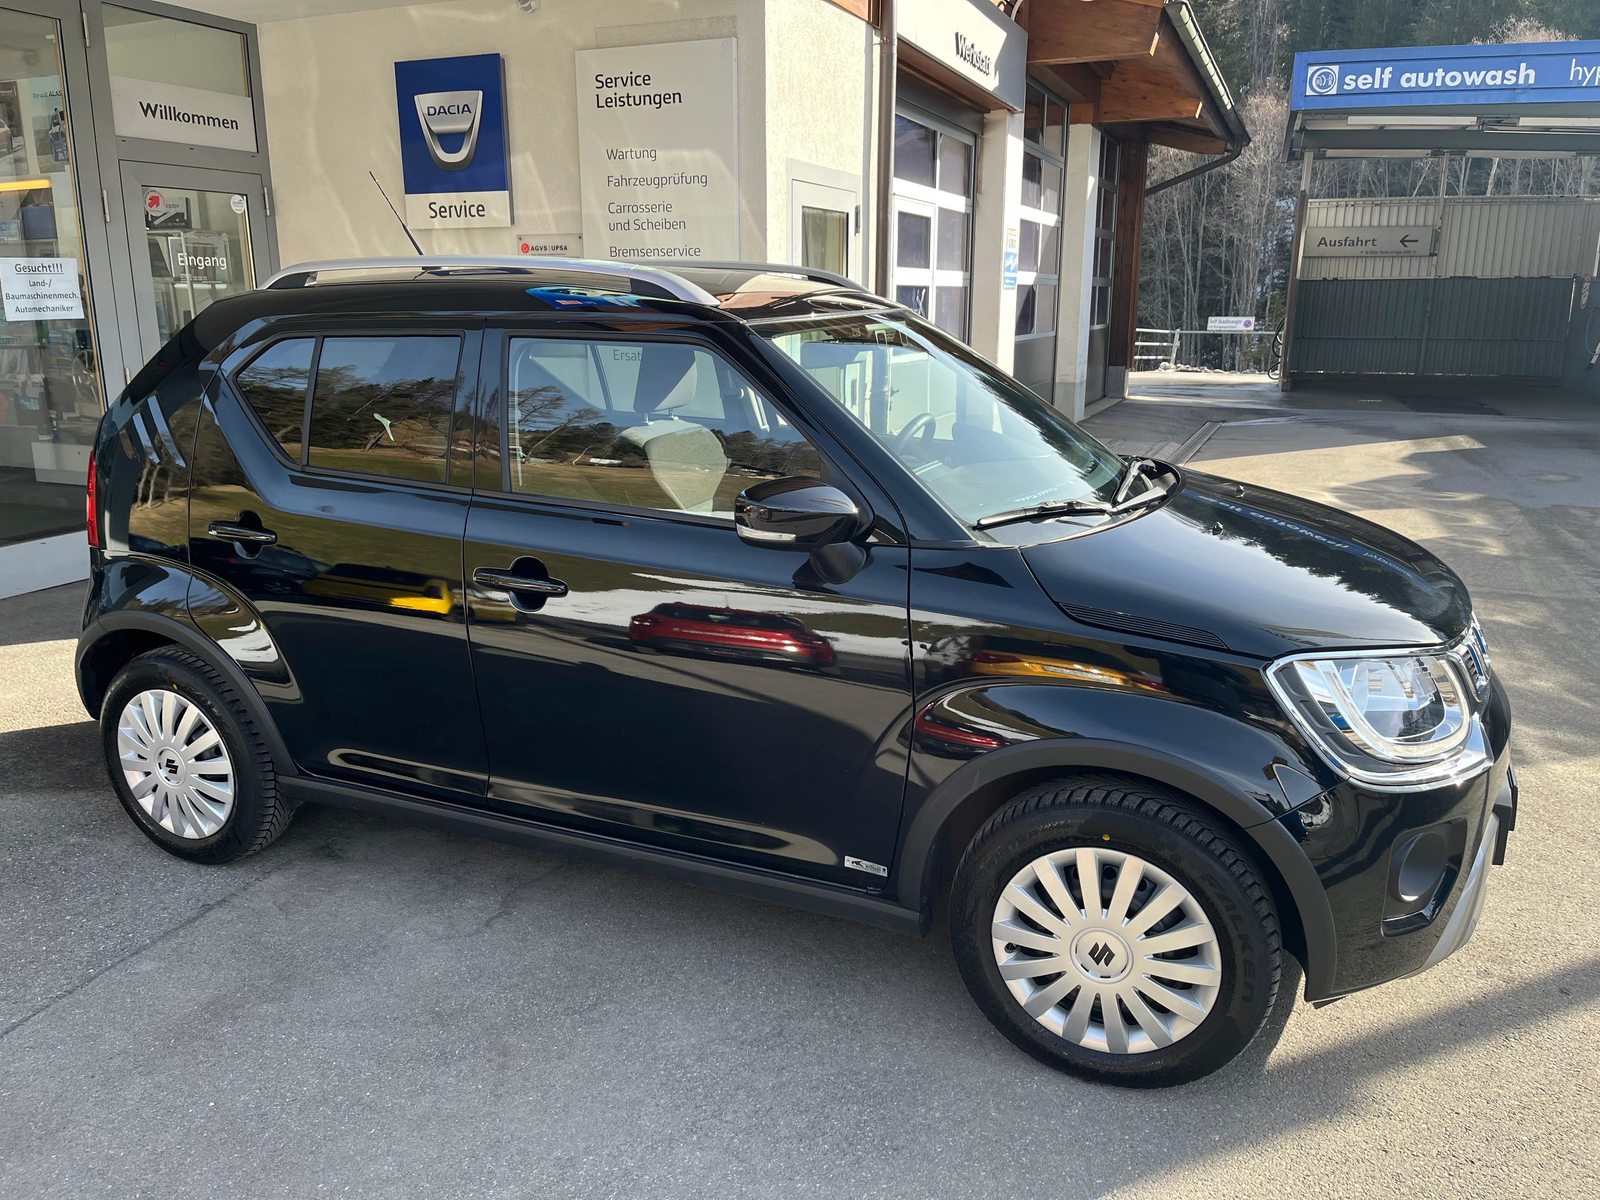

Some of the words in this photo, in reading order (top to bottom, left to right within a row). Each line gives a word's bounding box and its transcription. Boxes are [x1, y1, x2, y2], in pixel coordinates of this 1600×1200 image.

[595, 70, 652, 89] Service
[1343, 66, 1393, 90] self
[1400, 62, 1536, 89] autowash
[595, 90, 682, 109] Leistungen
[139, 101, 239, 130] Willkommen
[426, 103, 472, 117] DACIA
[605, 147, 657, 162] Wartung
[606, 172, 708, 189] Fahrzeugprüfung
[428, 200, 486, 219] Service
[607, 200, 673, 215] Carrosserie
[608, 217, 630, 231] und
[633, 217, 687, 231] Scheiben
[1317, 235, 1378, 247] Ausfahrt
[609, 244, 701, 258] Bremsenservice
[14, 263, 64, 273] Gesucht!!!
[177, 252, 227, 270] Eingang
[5, 291, 79, 300] Baumaschinenmech.
[15, 304, 74, 313] Automechaniker
